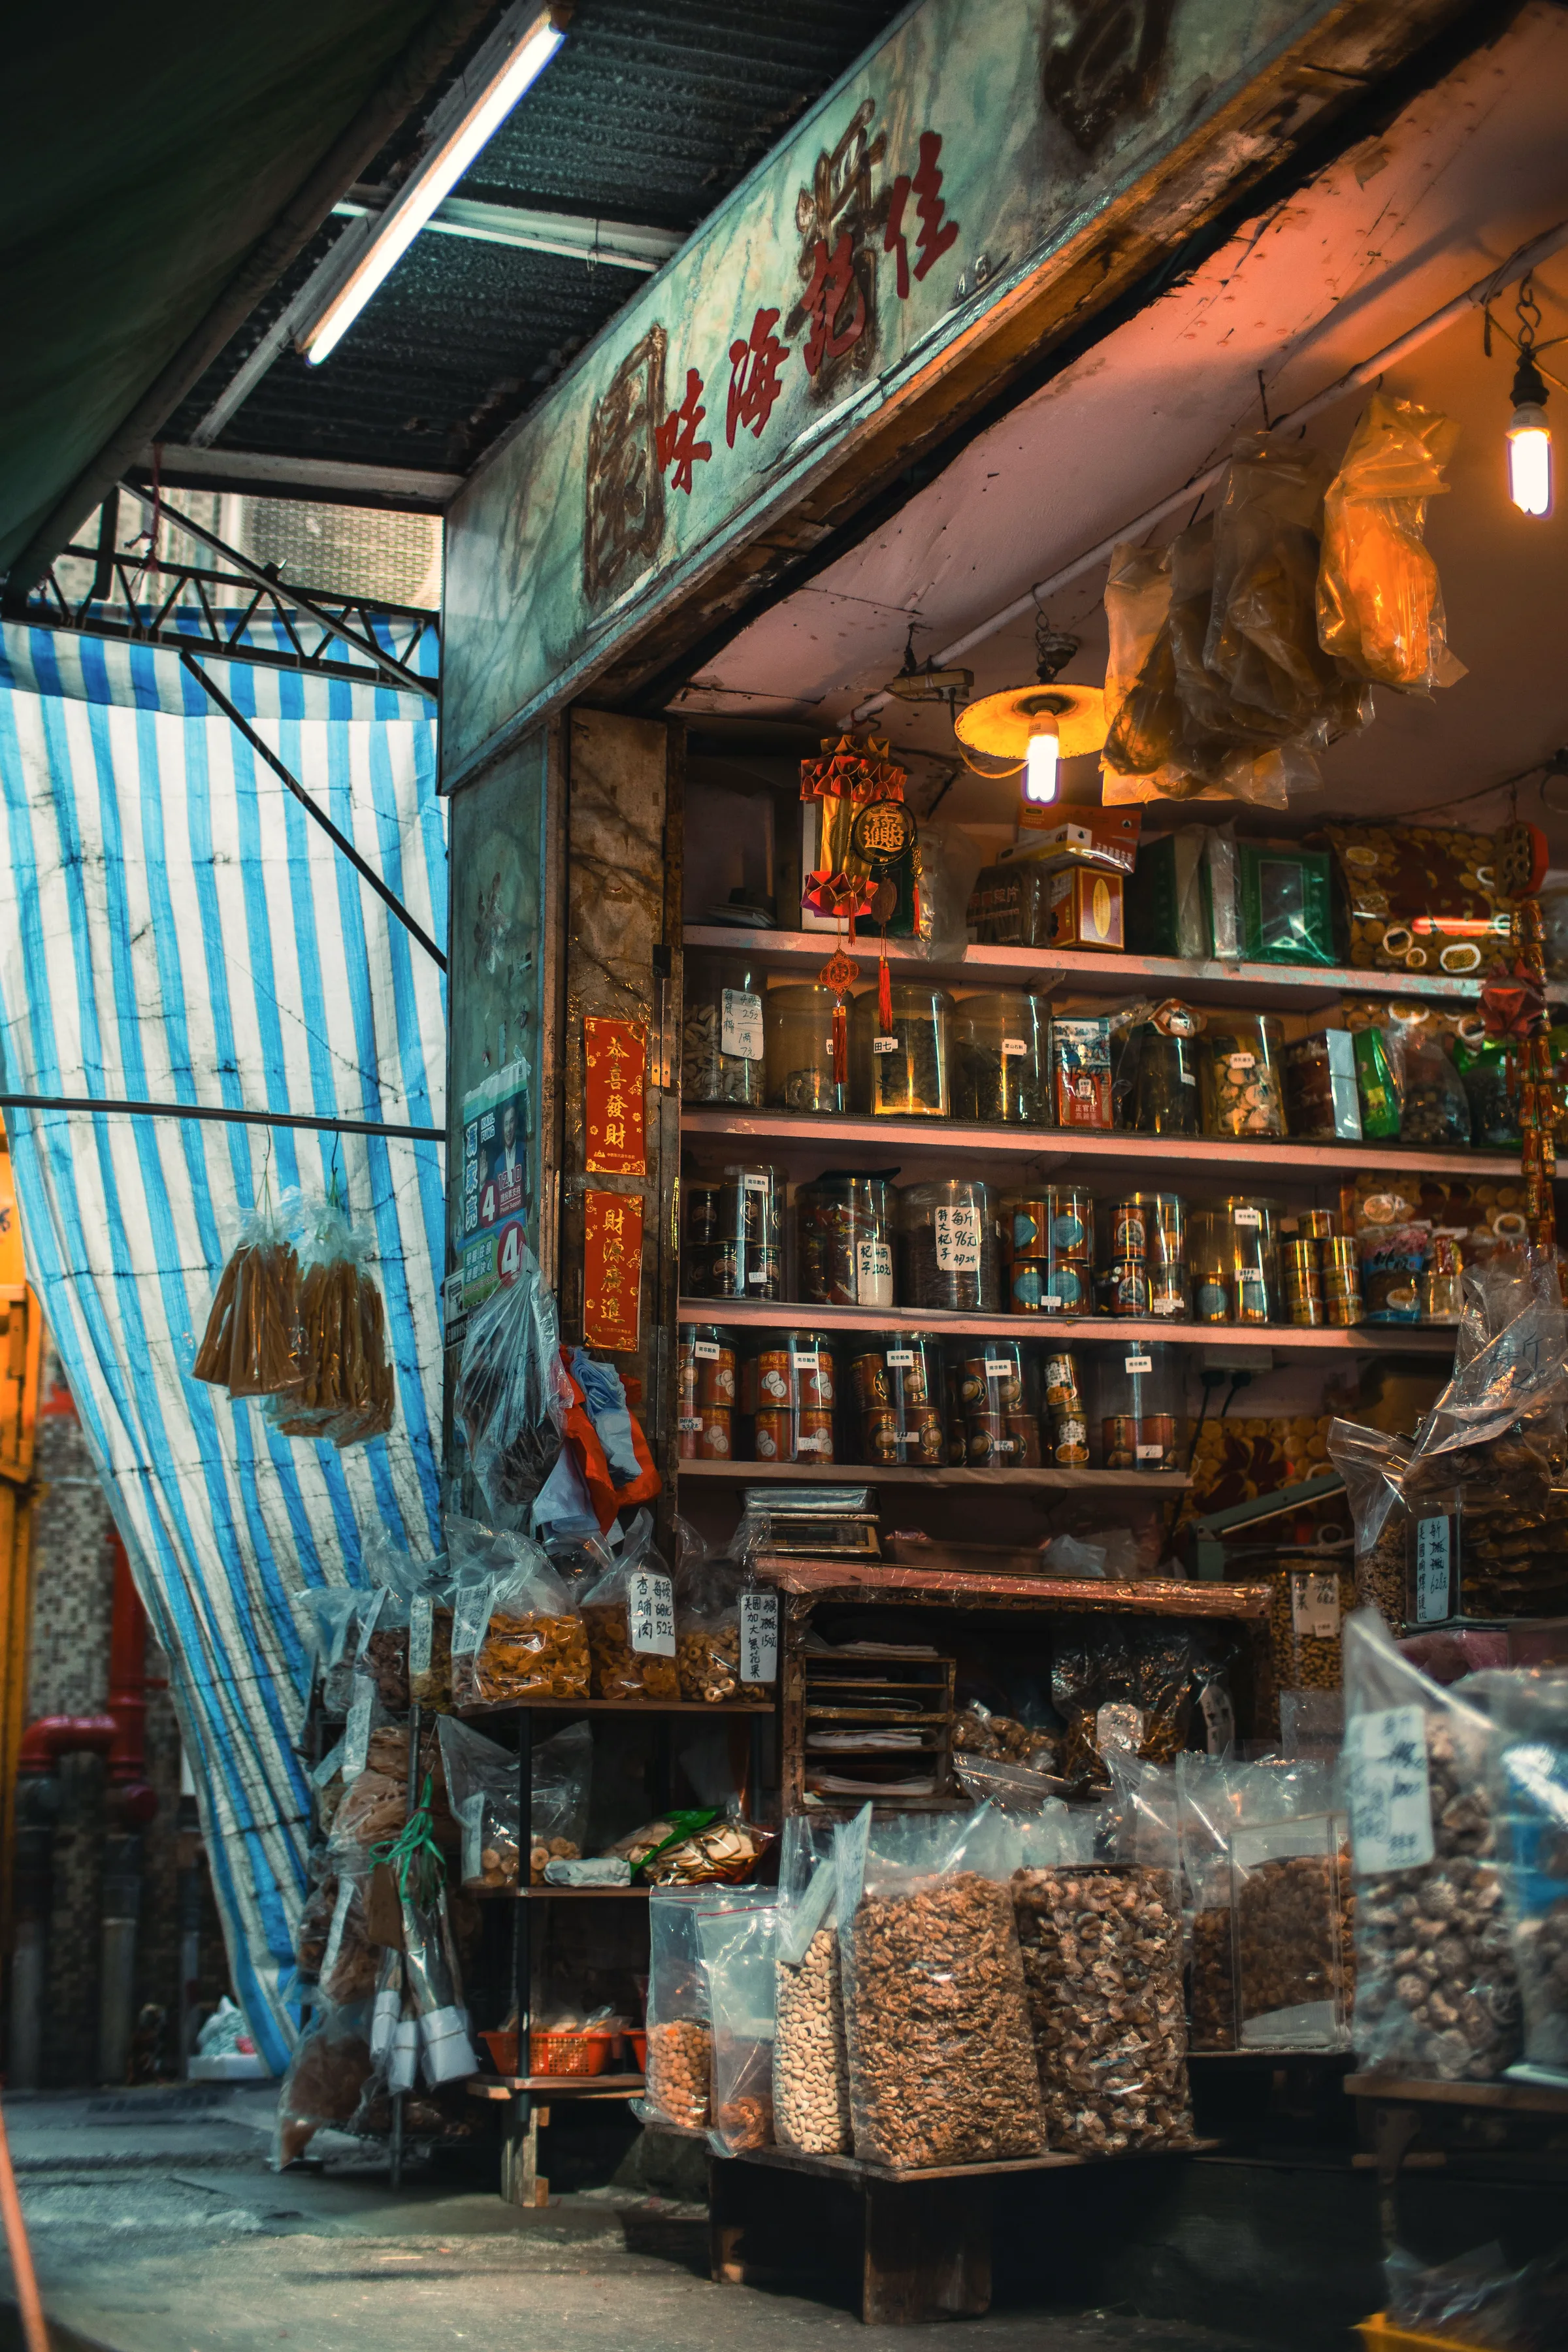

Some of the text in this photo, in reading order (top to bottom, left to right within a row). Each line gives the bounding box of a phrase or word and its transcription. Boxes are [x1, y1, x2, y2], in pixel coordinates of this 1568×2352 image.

[874, 1041, 892, 1052] 田七
[602, 1036, 630, 1150] 恭喜發財
[481, 1112, 495, 1130] KARL
[481, 1124, 495, 1143] FUNG
[465, 1121, 478, 1232] 馮家亮
[482, 1184, 496, 1222] 4
[951, 1209, 973, 1228] 每斤
[938, 1209, 953, 1260] 特大杞子
[955, 1230, 977, 1247] 96元
[501, 1226, 520, 1275] 4
[860, 1245, 872, 1275] 杞子
[600, 1207, 626, 1324] 財源廣進
[872, 1263, 891, 1276] 20元
[652, 1578, 671, 1603] 每磅
[1430, 1572, 1448, 1594] 628元
[656, 1620, 674, 1637] 52元
[761, 1633, 777, 1648] 150元
